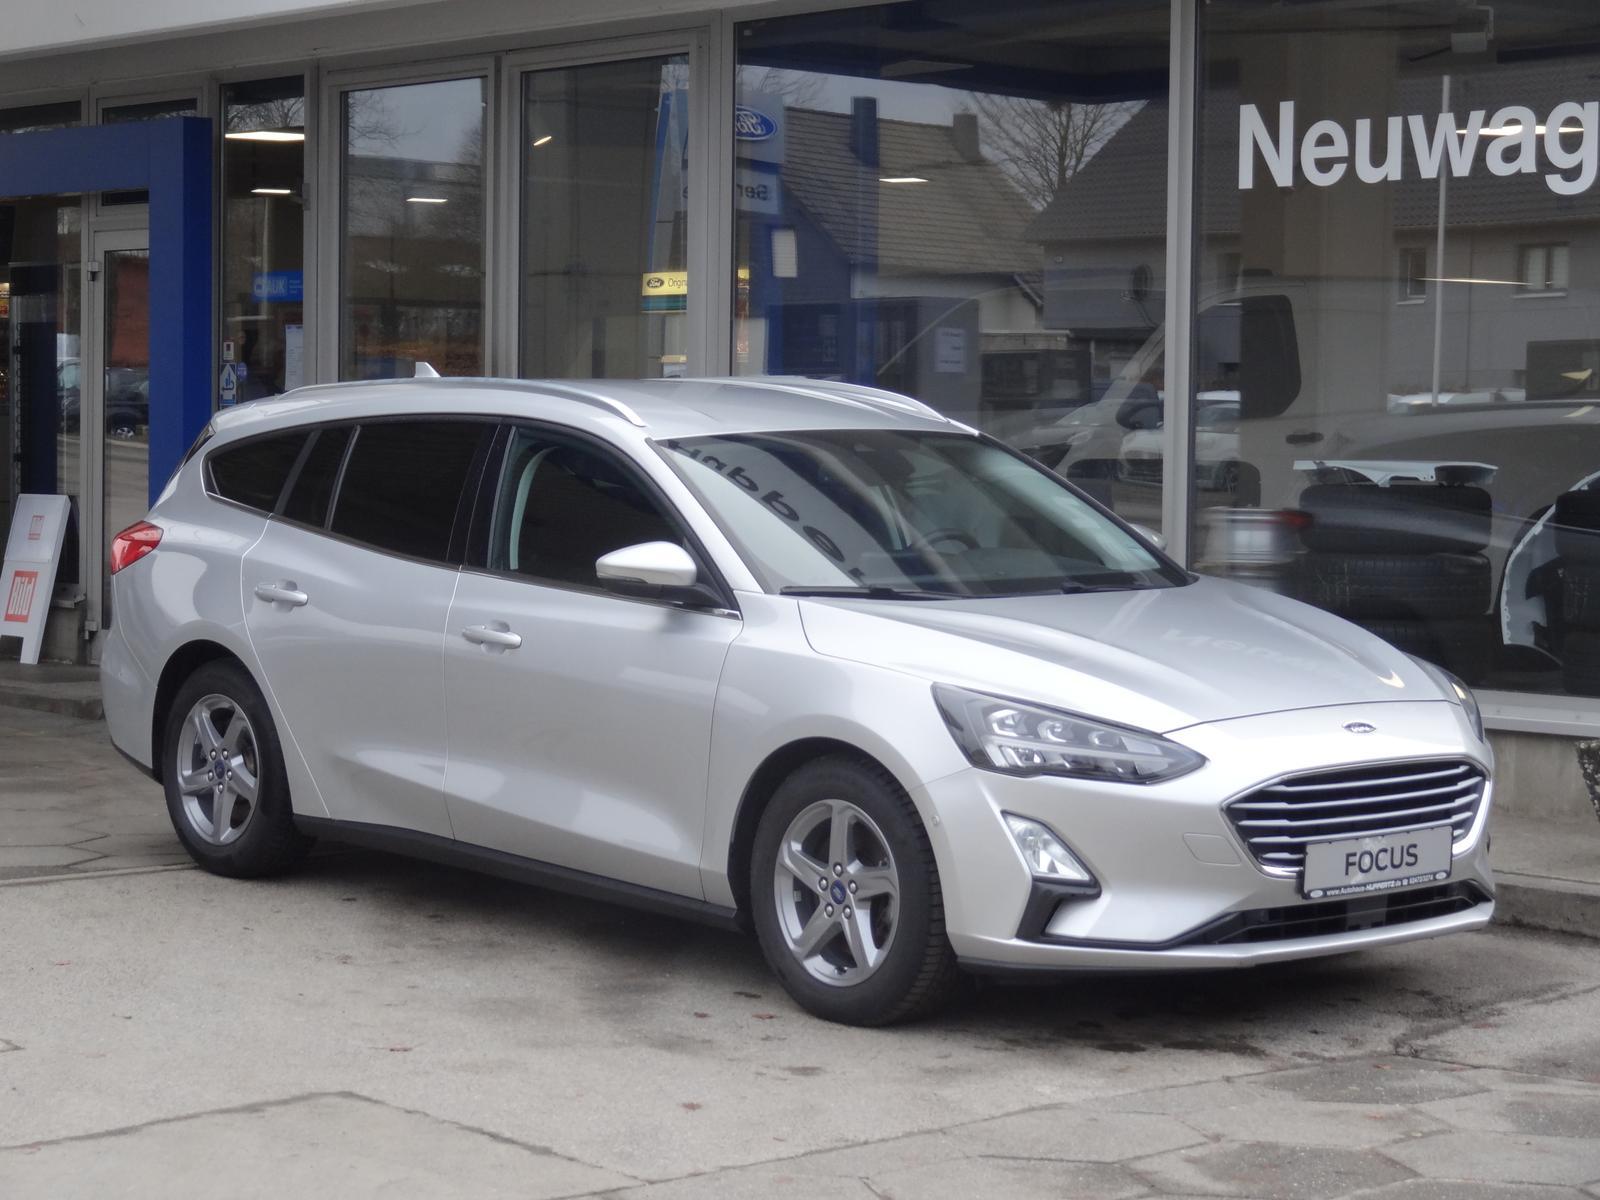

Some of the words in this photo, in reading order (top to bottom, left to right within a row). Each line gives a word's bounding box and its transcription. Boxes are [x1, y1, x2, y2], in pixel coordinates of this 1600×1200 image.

[1238, 100, 1600, 195] Neuwag
[8, 576, 36, 615] Bild
[1344, 843, 1418, 876] FOCUS
